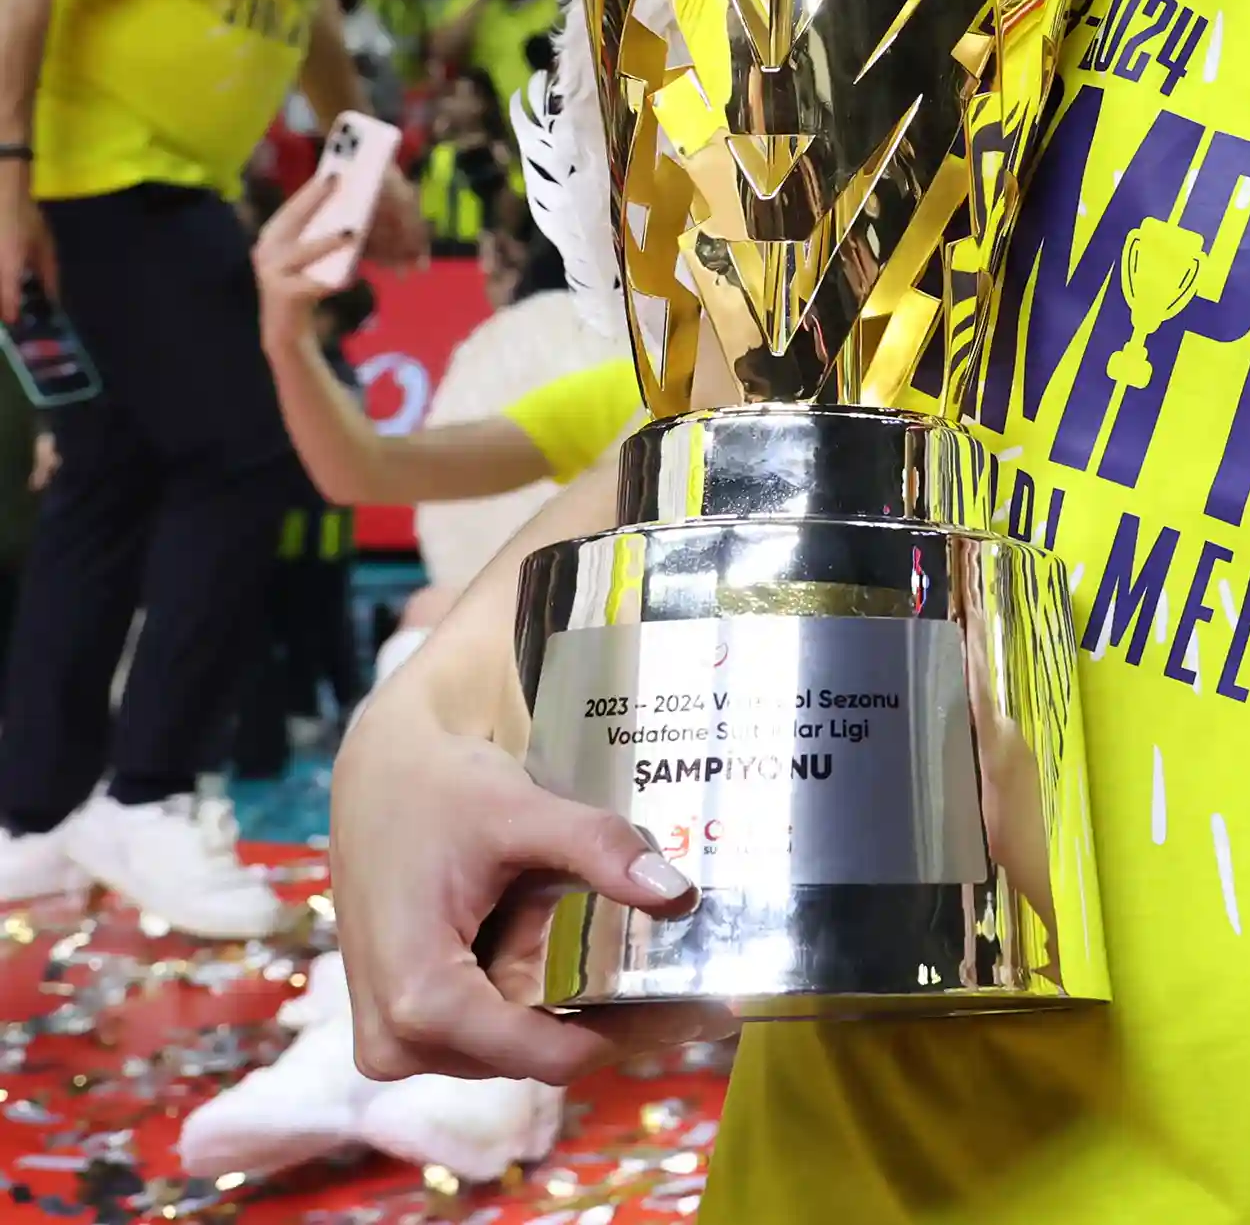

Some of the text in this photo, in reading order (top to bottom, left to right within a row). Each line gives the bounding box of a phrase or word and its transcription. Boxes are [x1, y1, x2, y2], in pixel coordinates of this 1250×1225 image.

[584, 697, 629, 718] 2023
[653, 694, 706, 714] 2024
[818, 689, 900, 710] Sezonu
[607, 723, 709, 745] Vodafone
[830, 719, 870, 742] Ligi
[634, 750, 834, 793] ŞAMPİYONU
